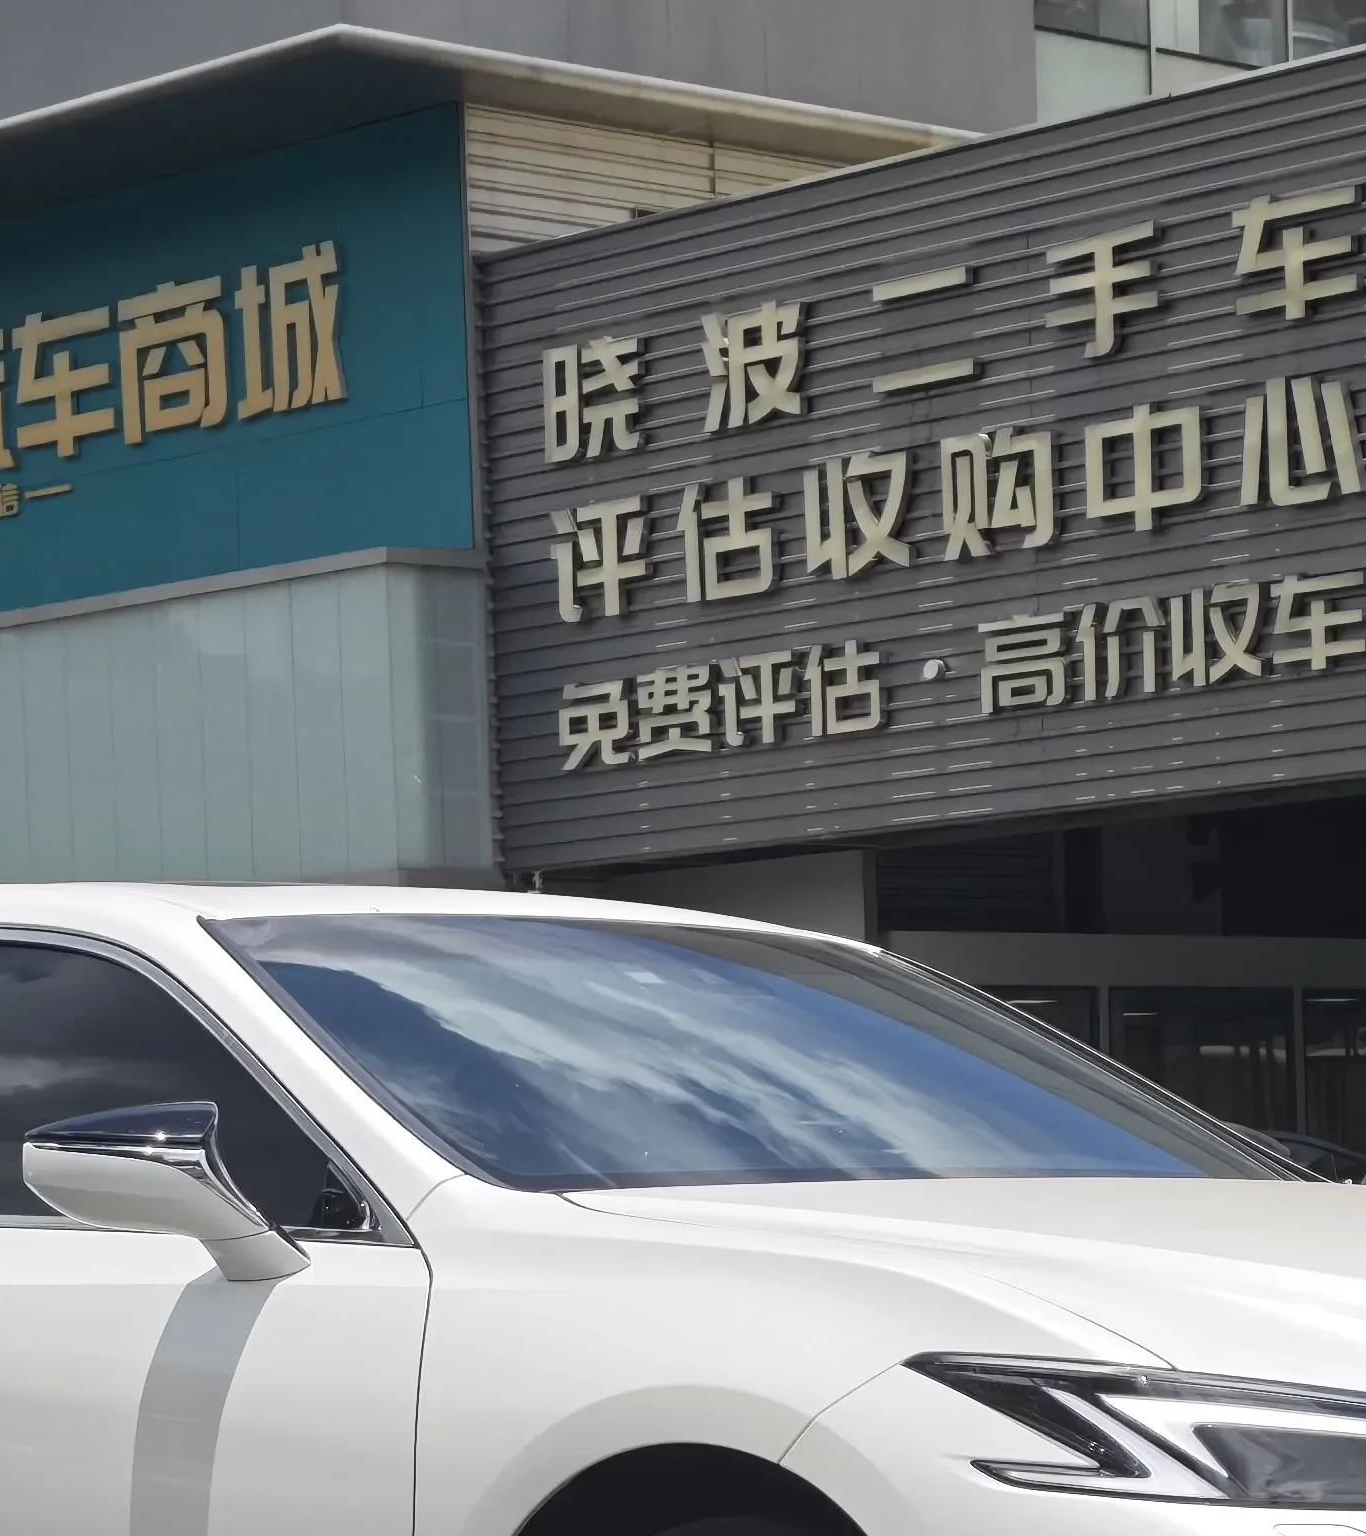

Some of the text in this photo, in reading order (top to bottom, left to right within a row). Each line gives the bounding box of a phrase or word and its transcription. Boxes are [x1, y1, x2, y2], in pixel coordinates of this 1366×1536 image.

[541, 183, 1366, 465] 晓波二手车
